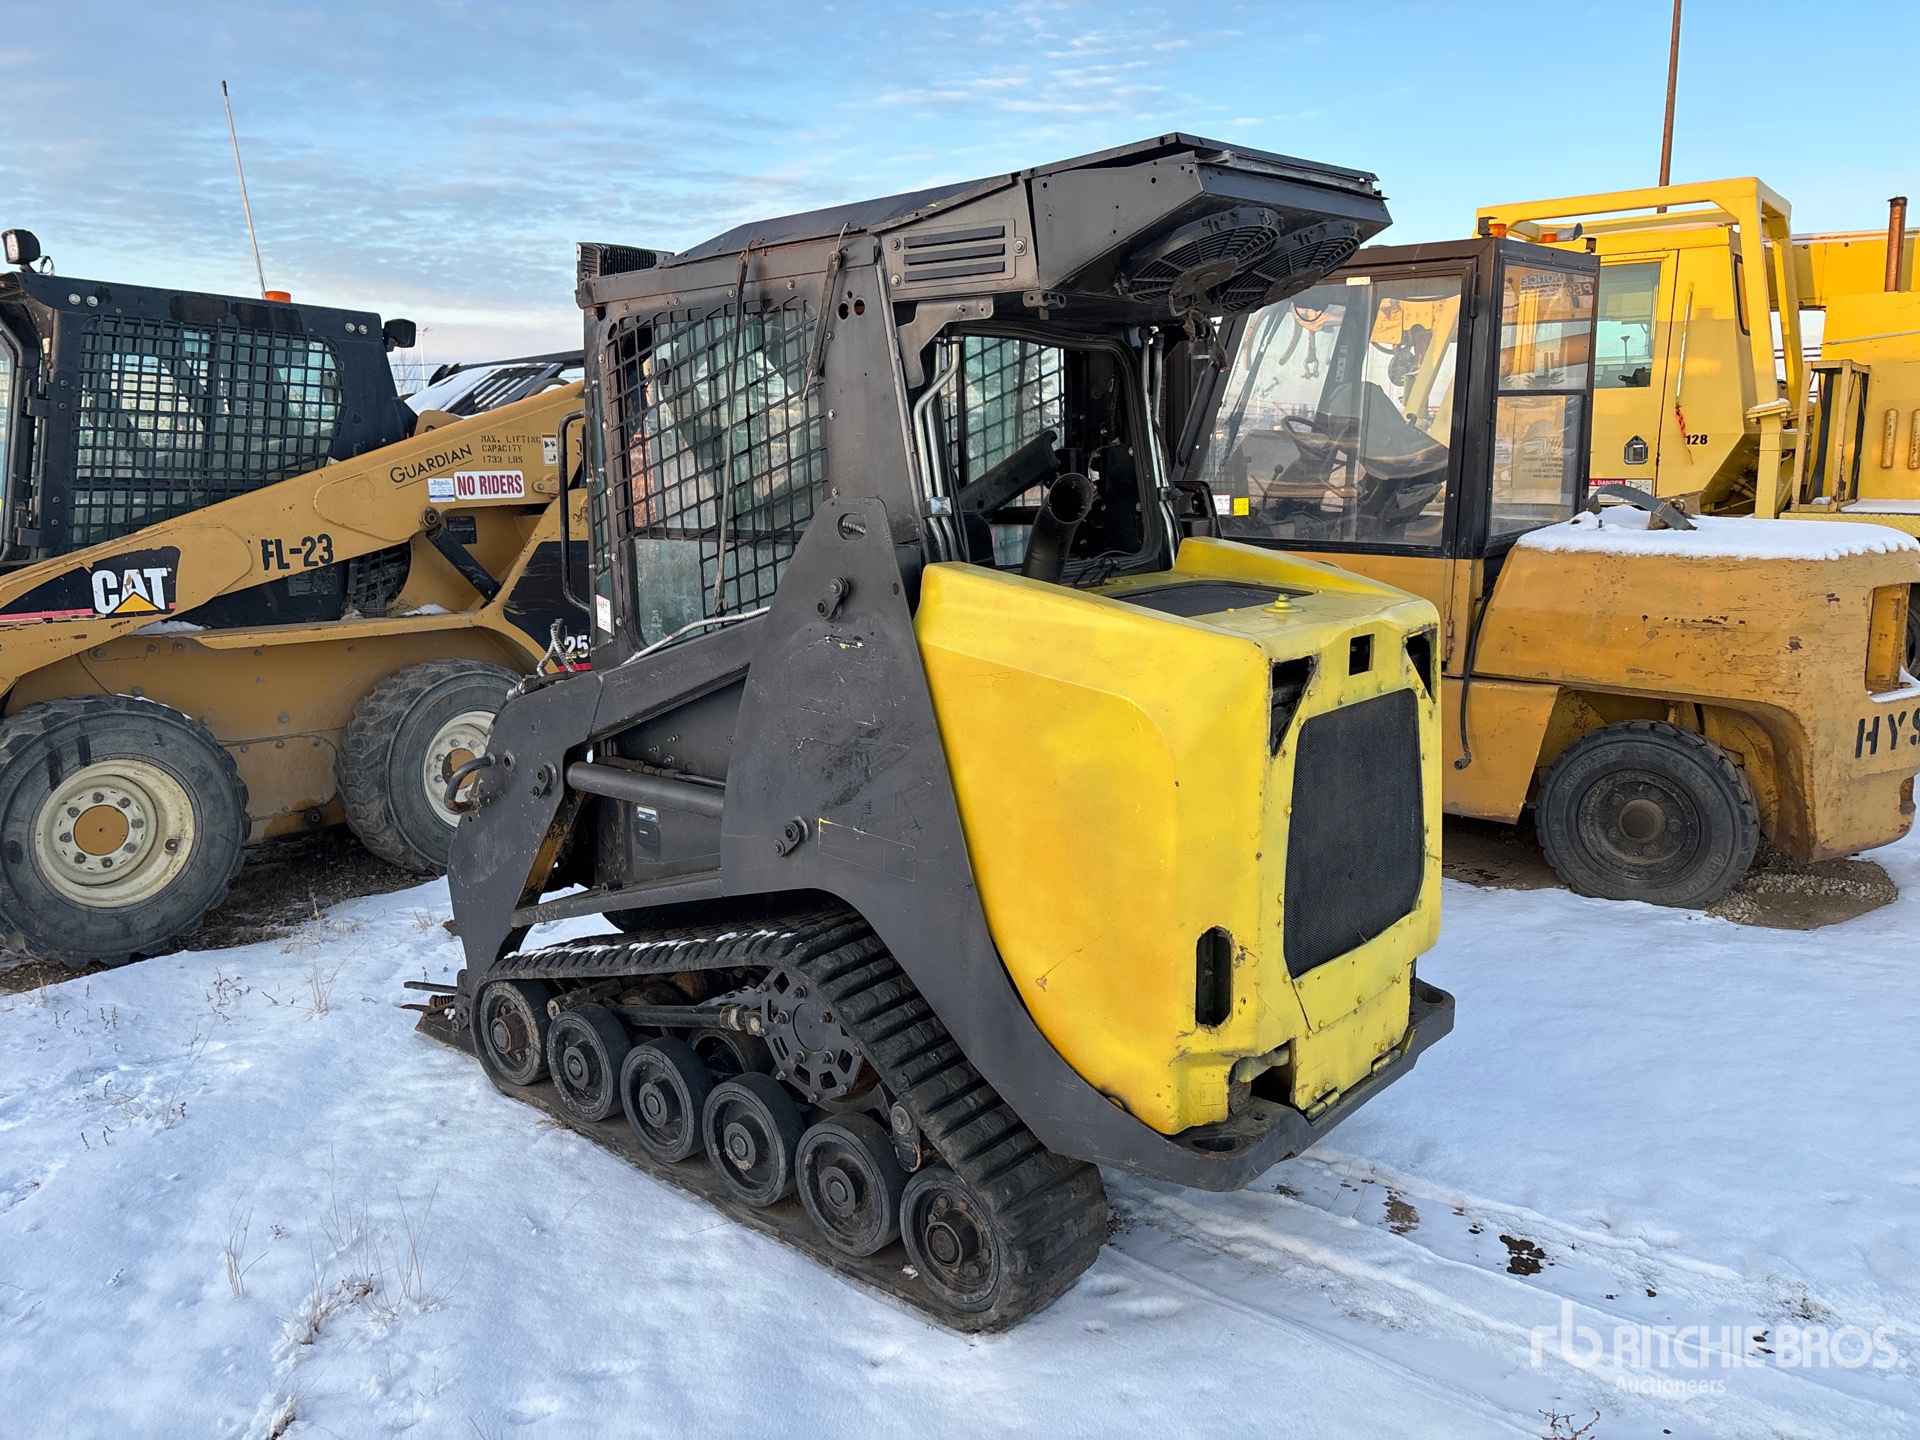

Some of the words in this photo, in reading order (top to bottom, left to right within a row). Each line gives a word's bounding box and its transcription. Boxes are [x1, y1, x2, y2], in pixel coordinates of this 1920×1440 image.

[481, 434, 501, 443] MAX.
[506, 434, 541, 444] LIFTING
[481, 444, 522, 453] CAPACITY
[1685, 434, 1708, 445] 128
[390, 443, 473, 484] GUARDIAN
[482, 455, 503, 464] 1733
[507, 456, 524, 464] LBS
[456, 475, 476, 496] NO
[479, 474, 523, 495] RIDERS
[260, 533, 335, 571] FL-23
[91, 567, 168, 614] CAT
[563, 634, 591, 659] 25
